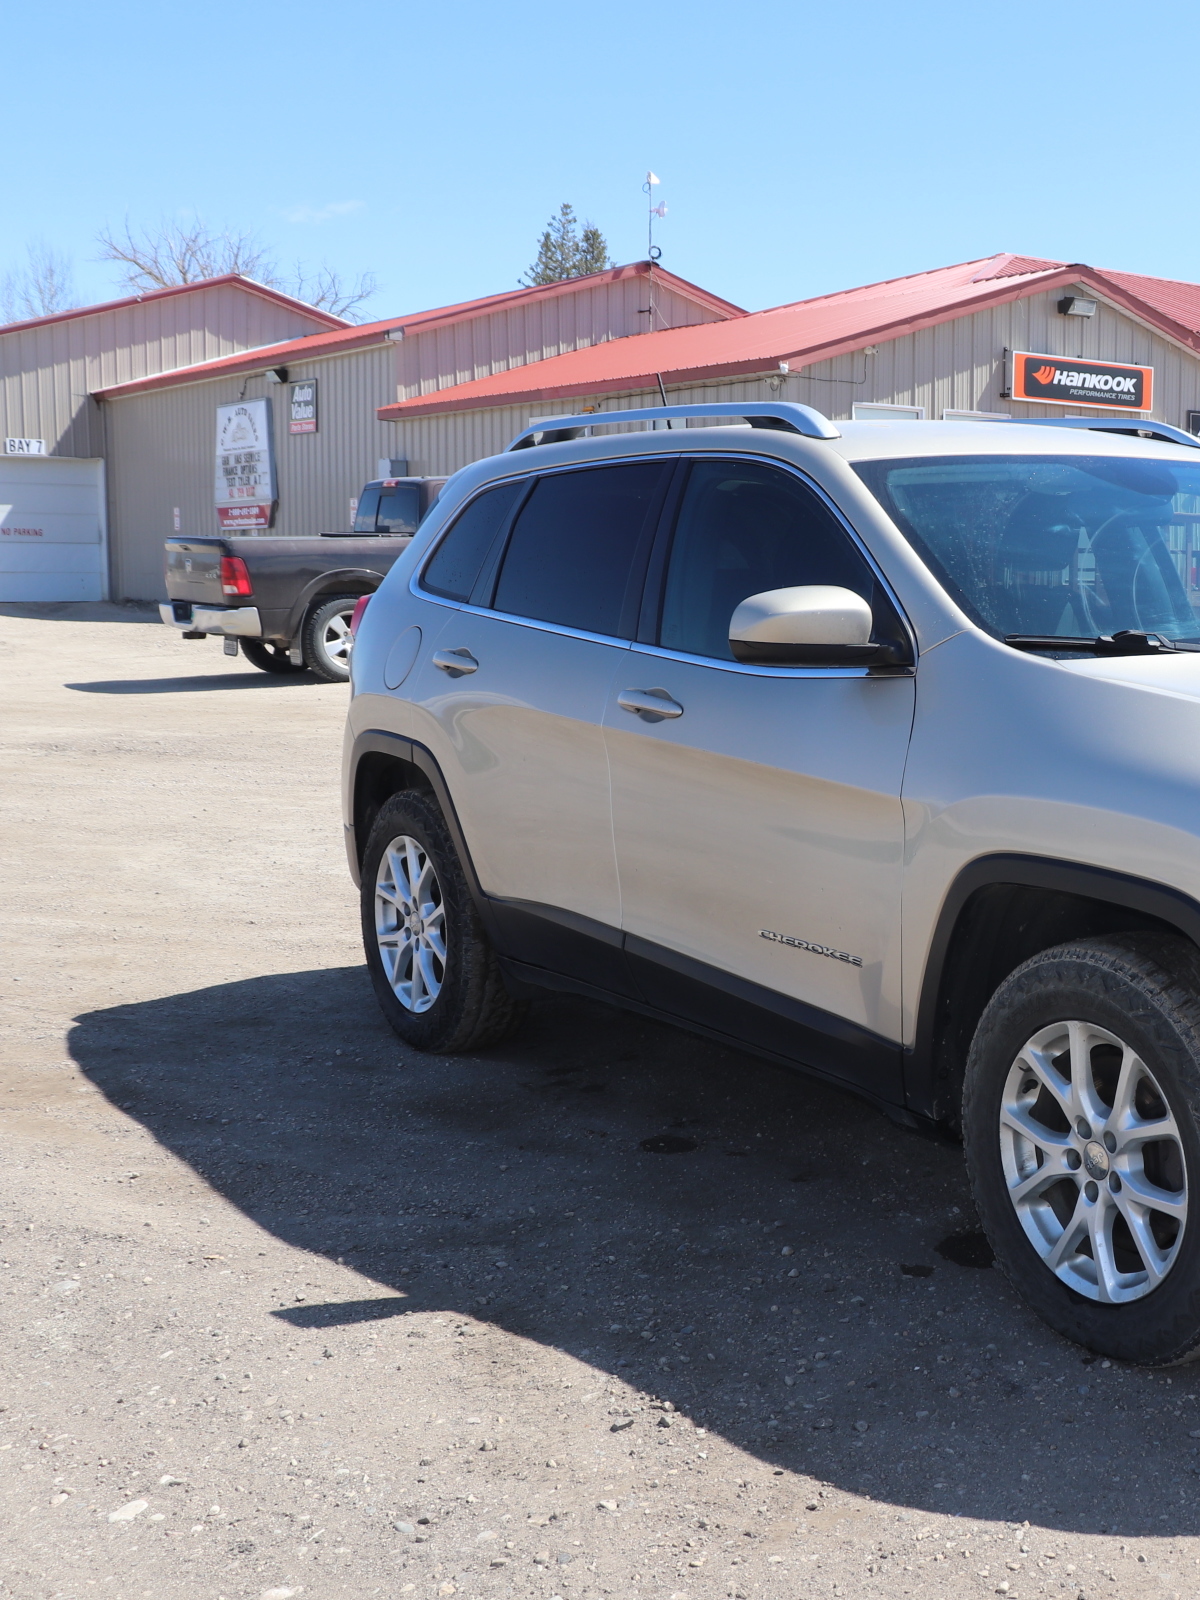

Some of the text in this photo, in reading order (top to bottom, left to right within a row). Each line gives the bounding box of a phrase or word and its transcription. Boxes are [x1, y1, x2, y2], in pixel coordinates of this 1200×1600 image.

[292, 385, 312, 402] Auto
[1069, 388, 1117, 399] PERFORMANCE
[291, 402, 313, 419] Value
[9, 439, 42, 453] BAY 7
[244, 452, 260, 463] SERVICE
[223, 464, 257, 476] FINANCE OPTIONS
[1, 527, 43, 537] NO PARKING
[758, 929, 863, 968] CHEROKEE
